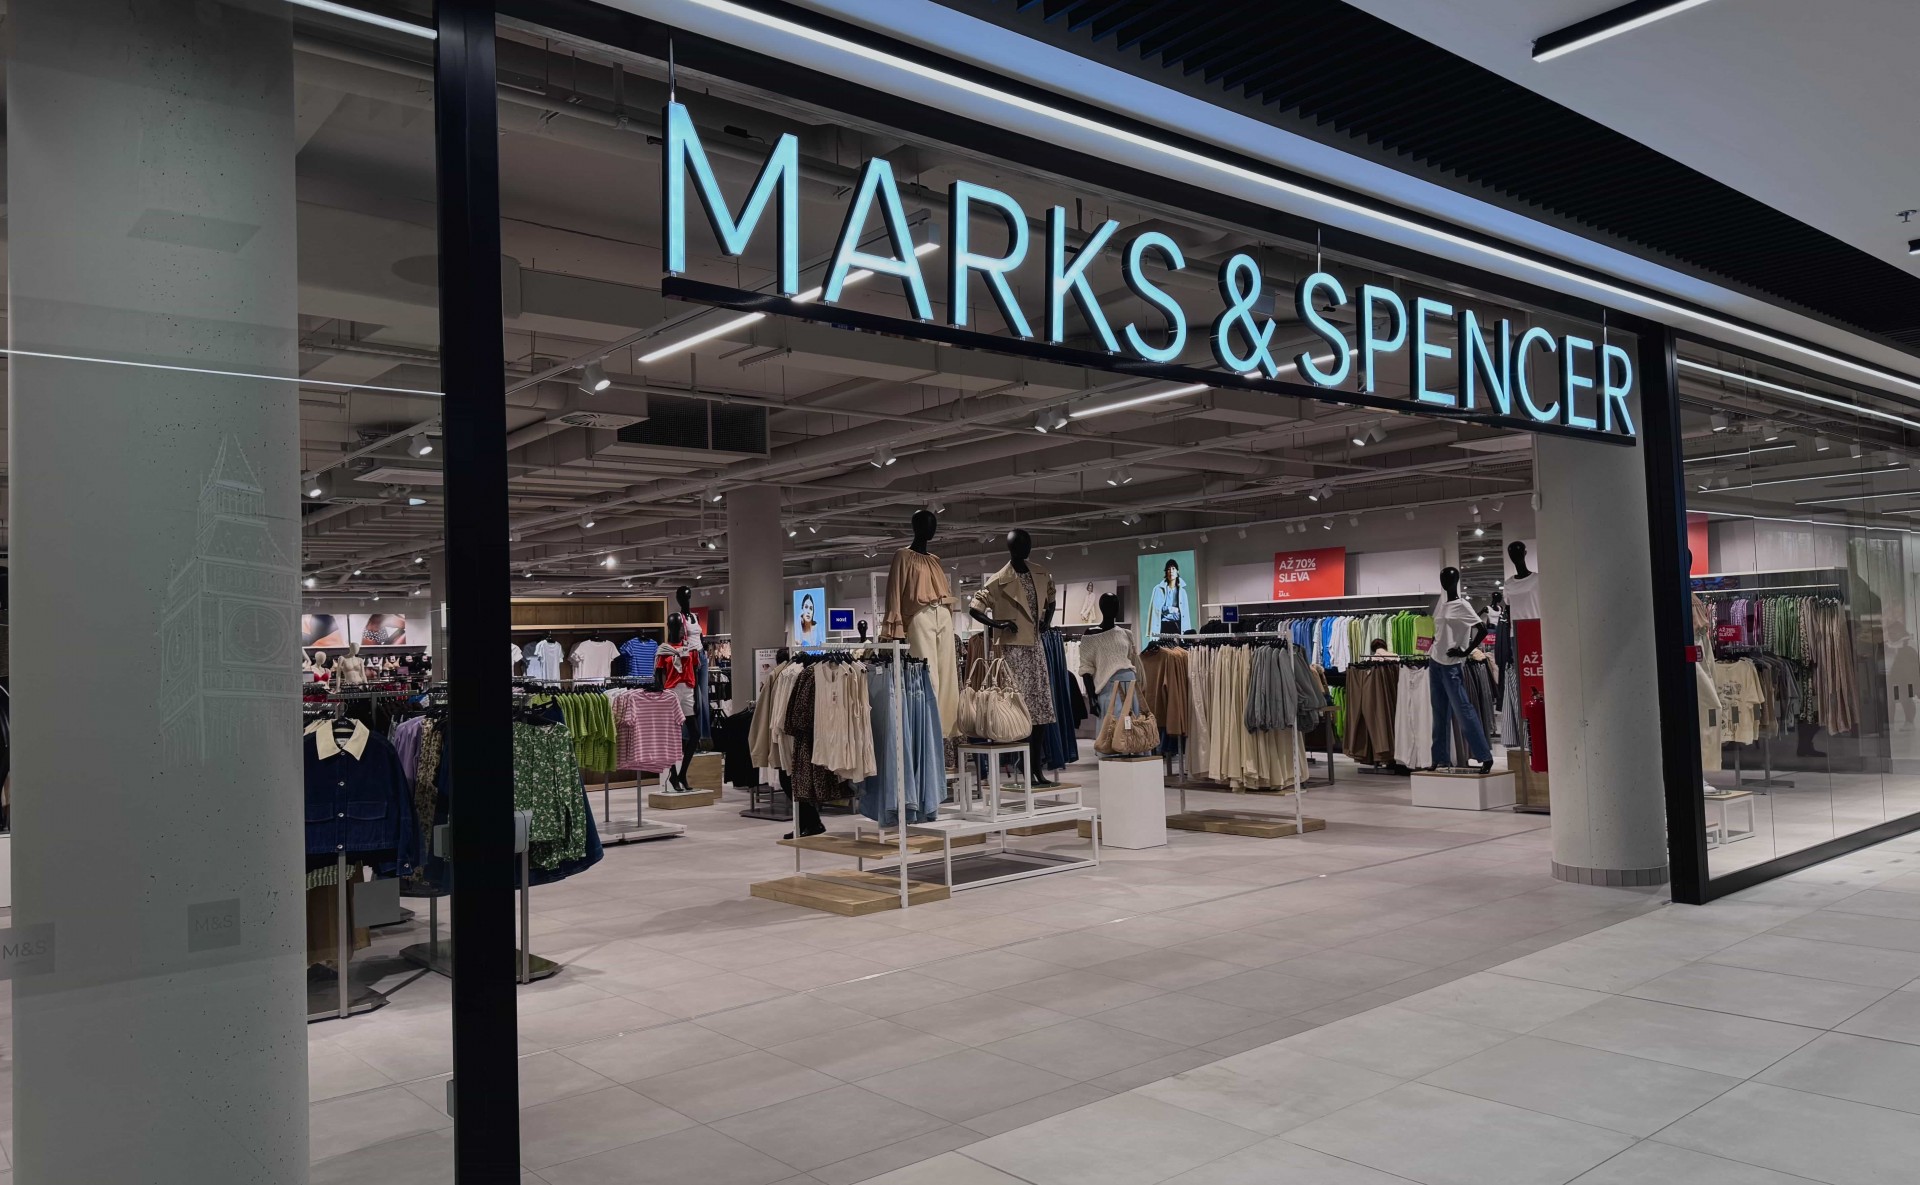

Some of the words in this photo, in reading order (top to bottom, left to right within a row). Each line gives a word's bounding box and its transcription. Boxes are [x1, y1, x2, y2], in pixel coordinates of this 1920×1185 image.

[662, 100, 1188, 362] MARKS
[1210, 254, 1279, 380] &
[1294, 272, 1637, 436] SPENCER
[1279, 557, 1293, 570] AŽ
[1295, 558, 1316, 569] 70%
[1279, 572, 1310, 583] SLEVA
[1523, 652, 1539, 663] AŽ
[1523, 667, 1543, 676] SLE
[195, 914, 233, 931] M&S
[3, 939, 48, 960] M&S
